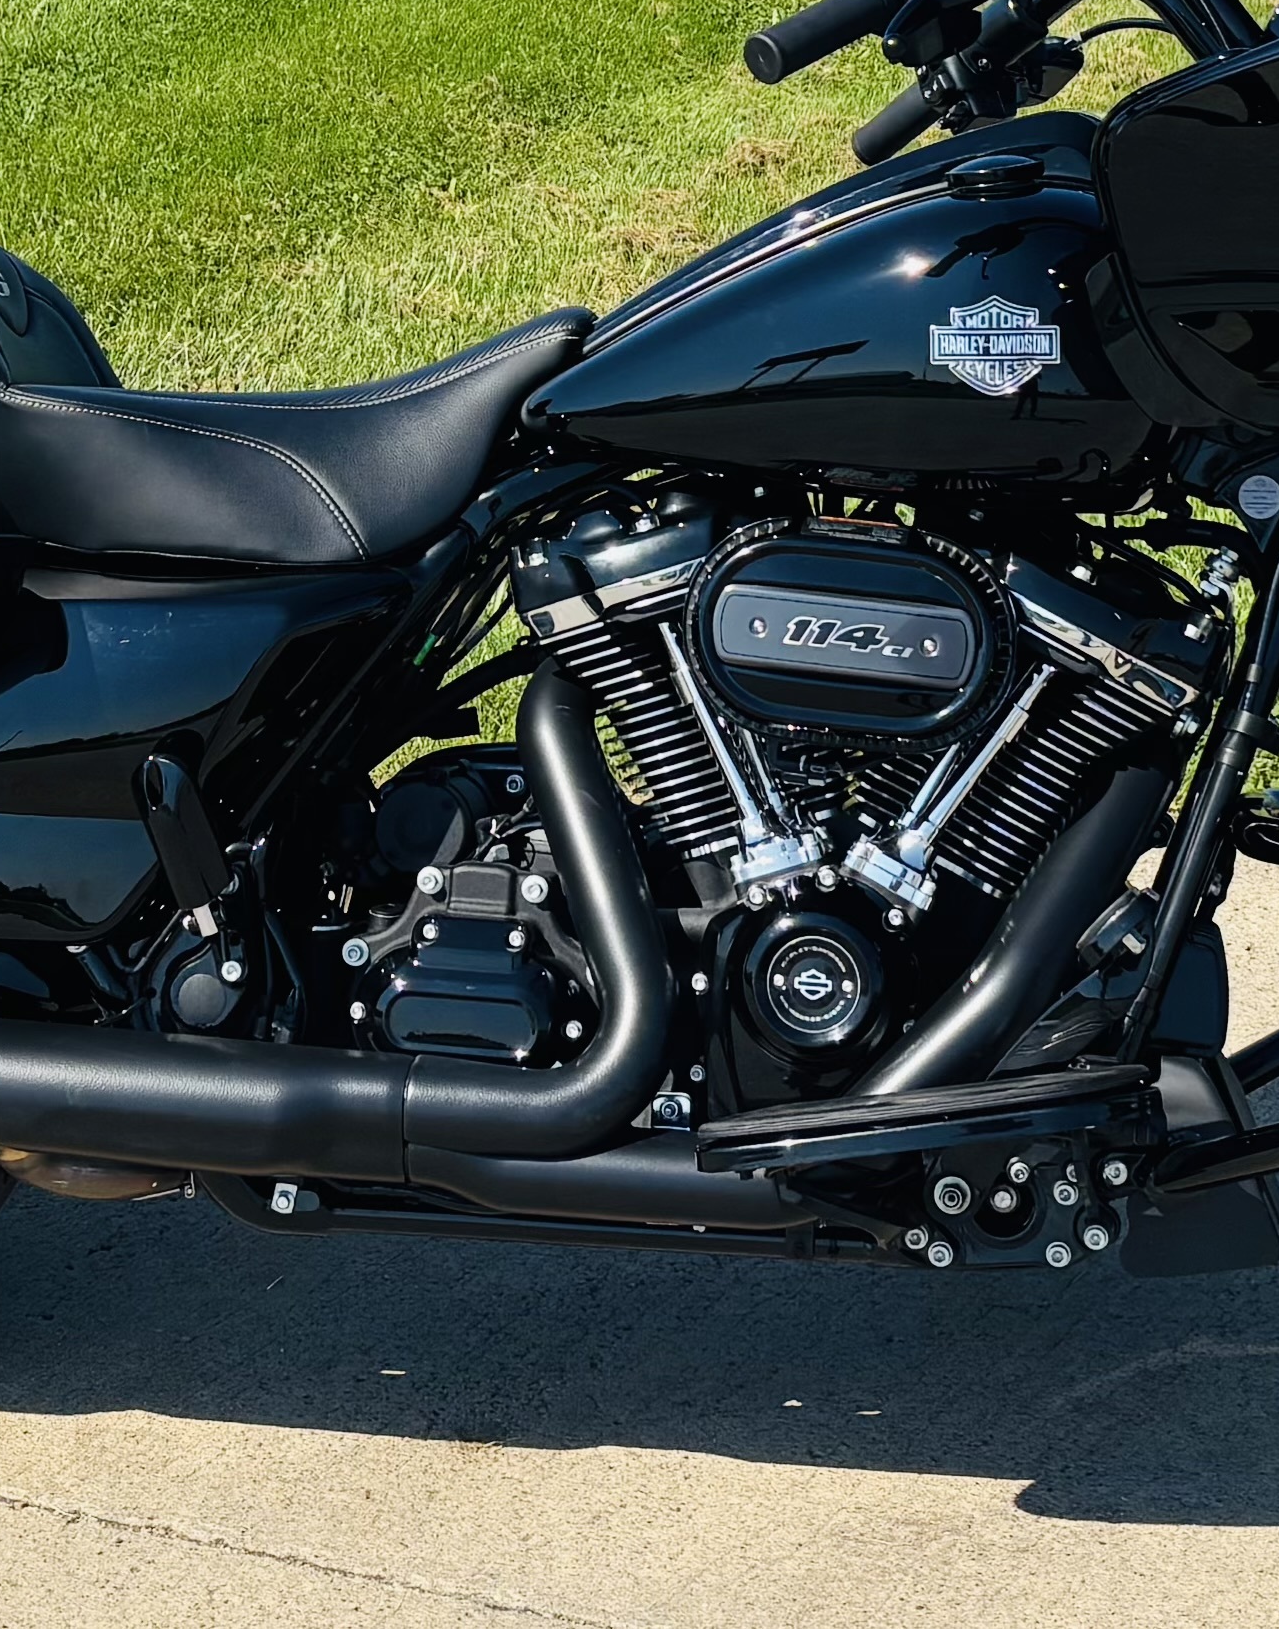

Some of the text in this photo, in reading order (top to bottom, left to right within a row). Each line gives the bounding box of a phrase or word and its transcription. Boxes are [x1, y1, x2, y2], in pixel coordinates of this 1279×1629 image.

[966, 307, 1027, 328] MOTOR
[939, 333, 1051, 355] HARLEY-DAVIDSON
[964, 360, 1023, 385] CYCLES
[782, 616, 890, 653] 114
